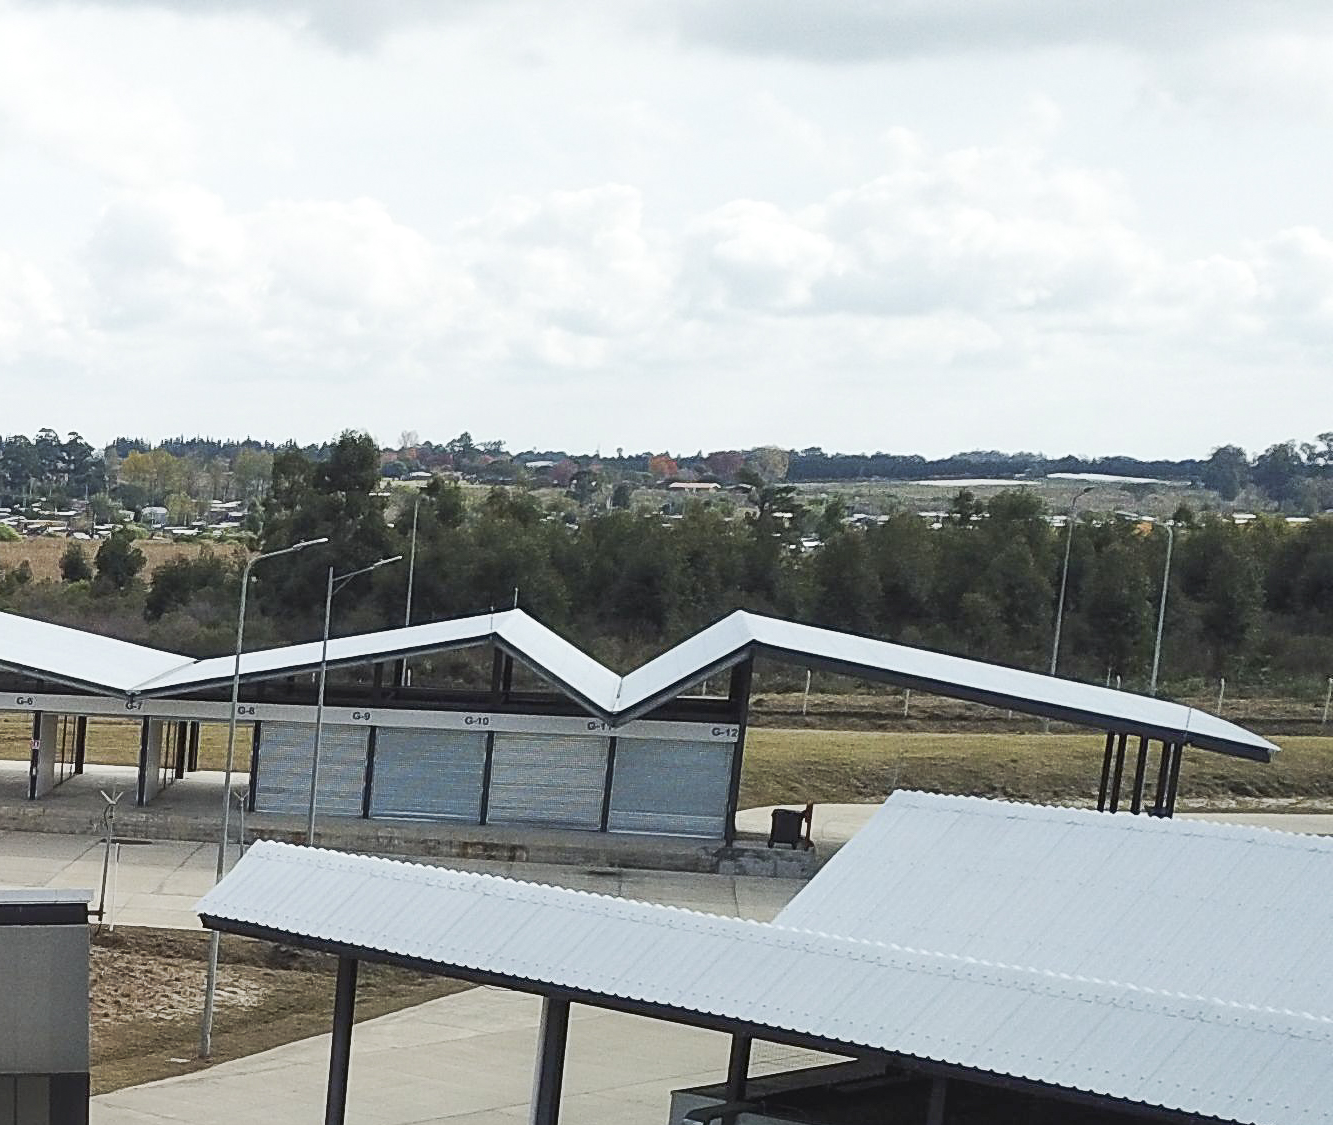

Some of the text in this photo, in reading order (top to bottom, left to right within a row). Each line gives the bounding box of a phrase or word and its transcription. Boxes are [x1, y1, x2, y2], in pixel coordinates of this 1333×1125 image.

[352, 711, 371, 721] G-9
[464, 716, 490, 726] G-10
[711, 727, 739, 738] G-12
